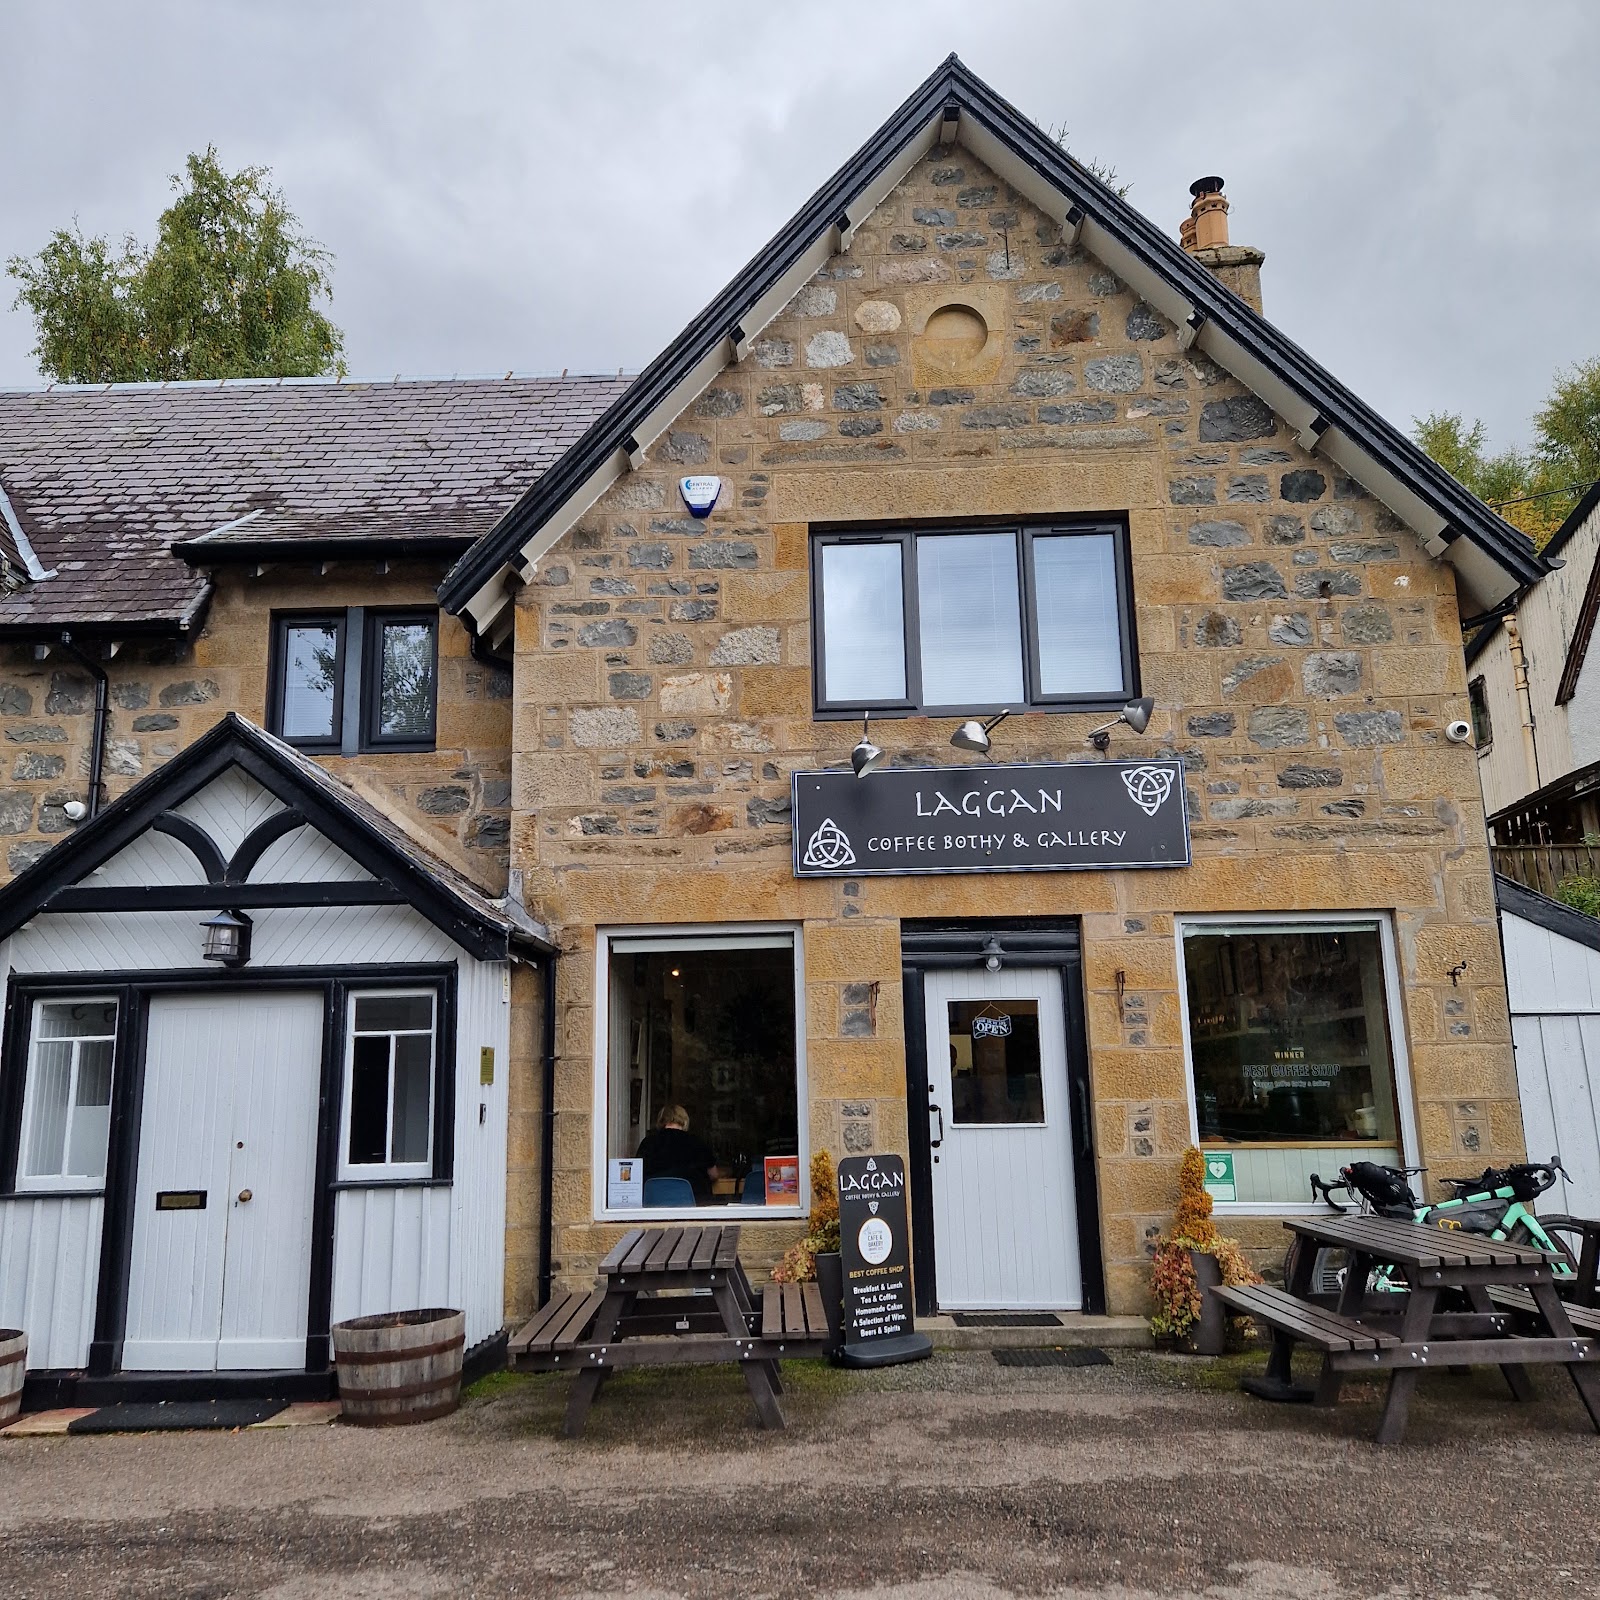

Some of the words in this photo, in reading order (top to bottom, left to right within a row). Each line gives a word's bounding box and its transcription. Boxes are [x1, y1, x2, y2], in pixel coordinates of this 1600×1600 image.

[915, 790, 1062, 818] LAGGAN
[868, 835, 936, 852] COFFEE
[944, 834, 1006, 850] BOTHY
[1013, 833, 1030, 848] &
[1037, 830, 1126, 848] GALLERY
[977, 1023, 1007, 1034] OPEN
[1242, 1064, 1268, 1077] BEST
[1270, 1063, 1310, 1077] COFFEE
[1311, 1063, 1340, 1076] SHOP
[840, 1172, 904, 1191] LAGGAN
[849, 1270, 864, 1278] BEST
[865, 1268, 888, 1276] COFFEE
[889, 1265, 904, 1274] SHOP
[853, 1284, 880, 1294] Breakfast
[887, 1281, 903, 1290] Lunch
[860, 1296, 871, 1304] Tea
[879, 1293, 897, 1302] Coffee
[855, 1305, 886, 1316] Homemade
[886, 1303, 903, 1311] Cakes
[859, 1317, 884, 1326] Selection
[885, 1314, 891, 1322] of
[860, 1329, 877, 1337] Beers
[884, 1325, 900, 1334] Spirits
